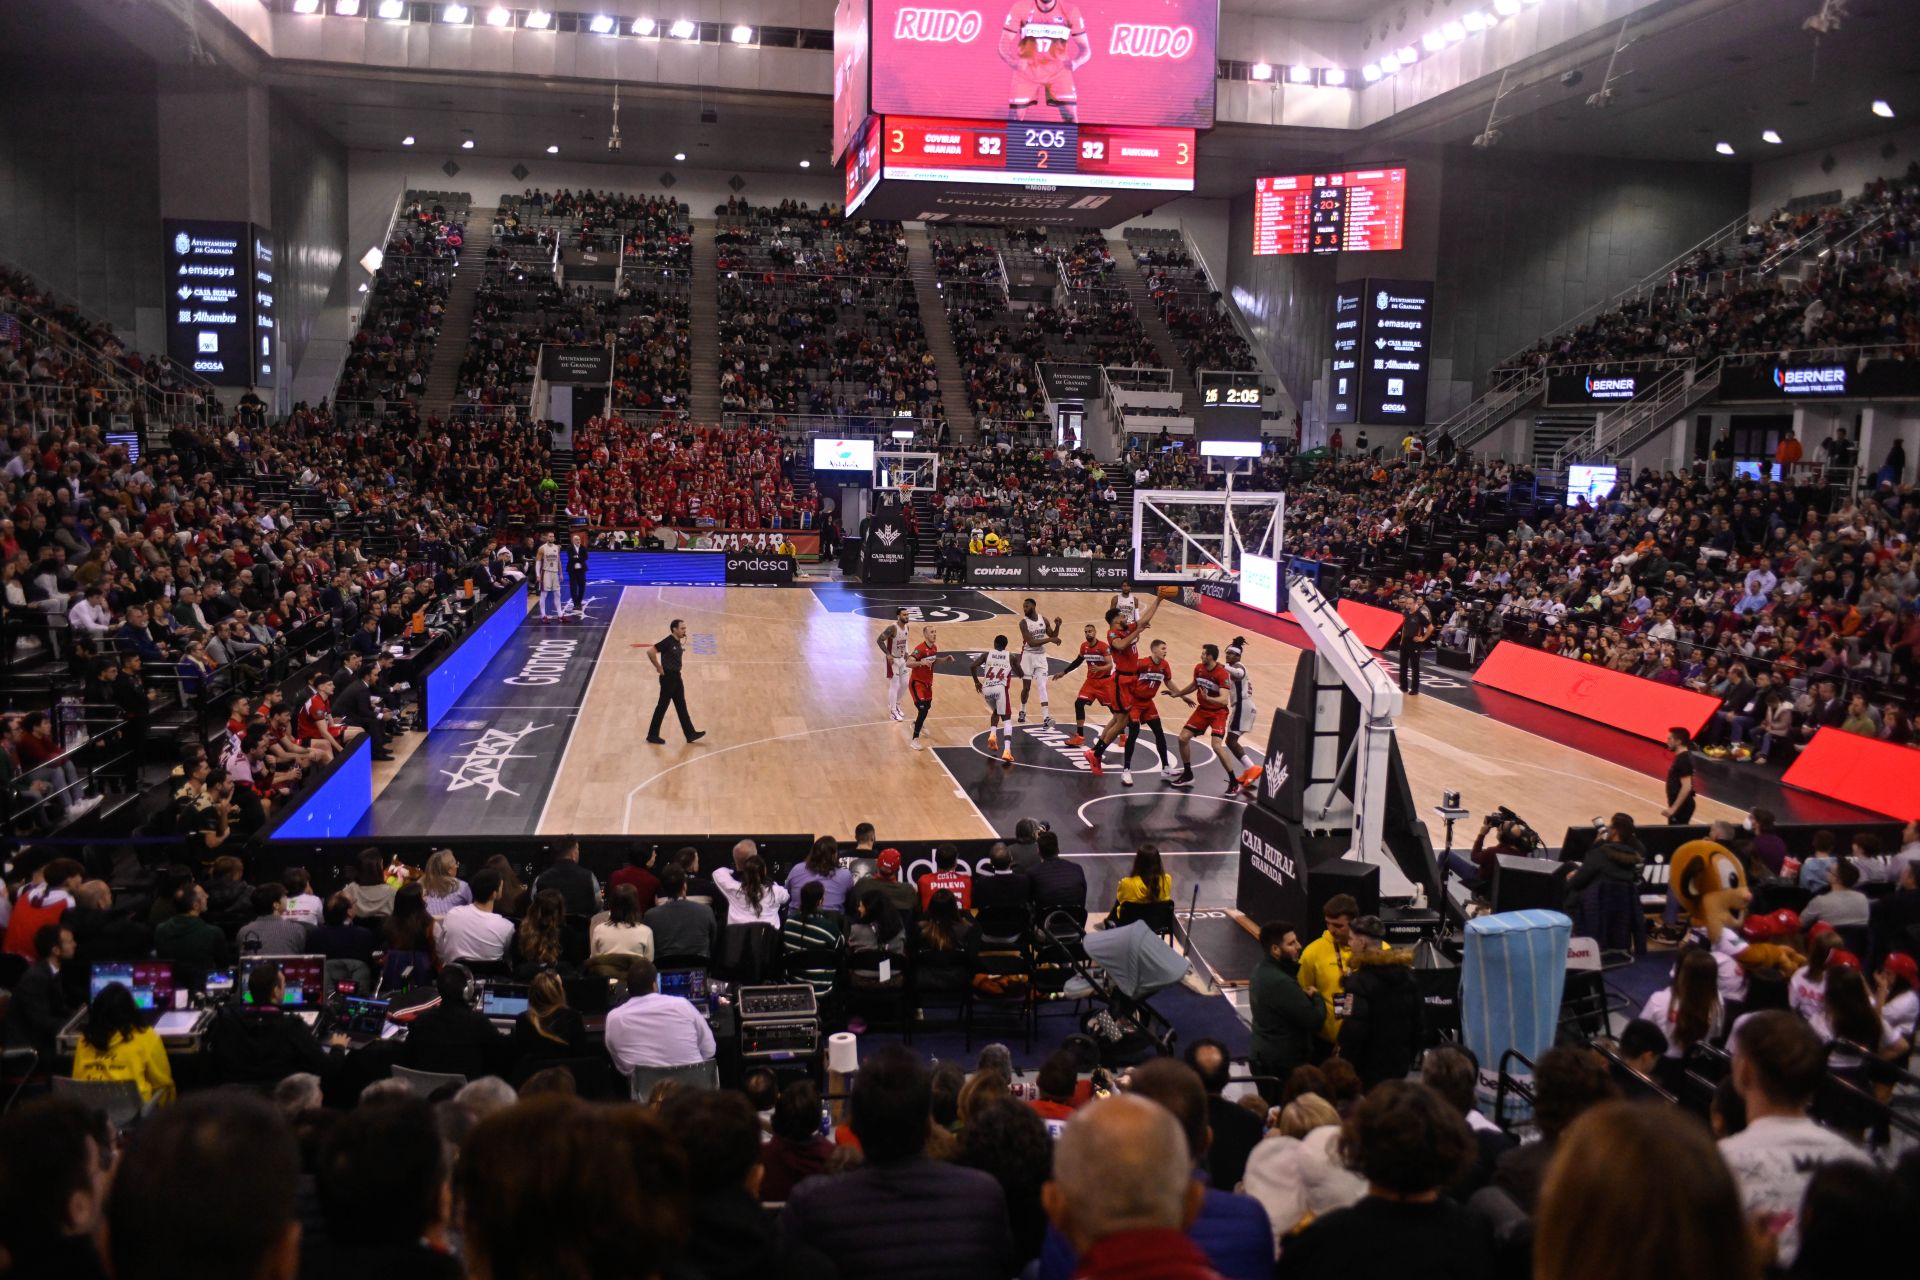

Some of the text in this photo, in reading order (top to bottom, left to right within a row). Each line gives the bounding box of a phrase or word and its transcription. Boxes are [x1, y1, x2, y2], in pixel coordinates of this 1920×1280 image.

[894, 8, 982, 43] RUIDO
[1036, 39, 1052, 52] 17
[1109, 23, 1195, 58] RUIDO
[891, 130, 904, 153] 3
[1025, 129, 1065, 147] 2:05
[923, 145, 962, 155] GRANADA
[978, 137, 1001, 155] 32
[1082, 142, 1104, 159] 32
[1037, 150, 1048, 169] 2
[1176, 143, 1189, 165] 3
[1030, 184, 1057, 192] MONDO
[188, 267, 235, 278] emasagra
[194, 288, 238, 298] CAJA RURAL
[193, 312, 237, 323] Alhambra
[1384, 320, 1422, 330] emasagra
[1402, 340, 1422, 348] RURAL
[1384, 360, 1420, 370] Alhambra
[1785, 369, 1845, 384] BERNER
[1593, 379, 1635, 391] BERNER
[1226, 388, 1260, 403] 2:05
[727, 557, 789, 571] endesa
[1201, 582, 1225, 598] endesa
[503, 639, 578, 687] Granada
[985, 666, 1005, 681] 44
[1241, 829, 1296, 879] CAJA RURAL
[1251, 854, 1283, 886] GRANADA
[930, 881, 966, 890] PULEVA
